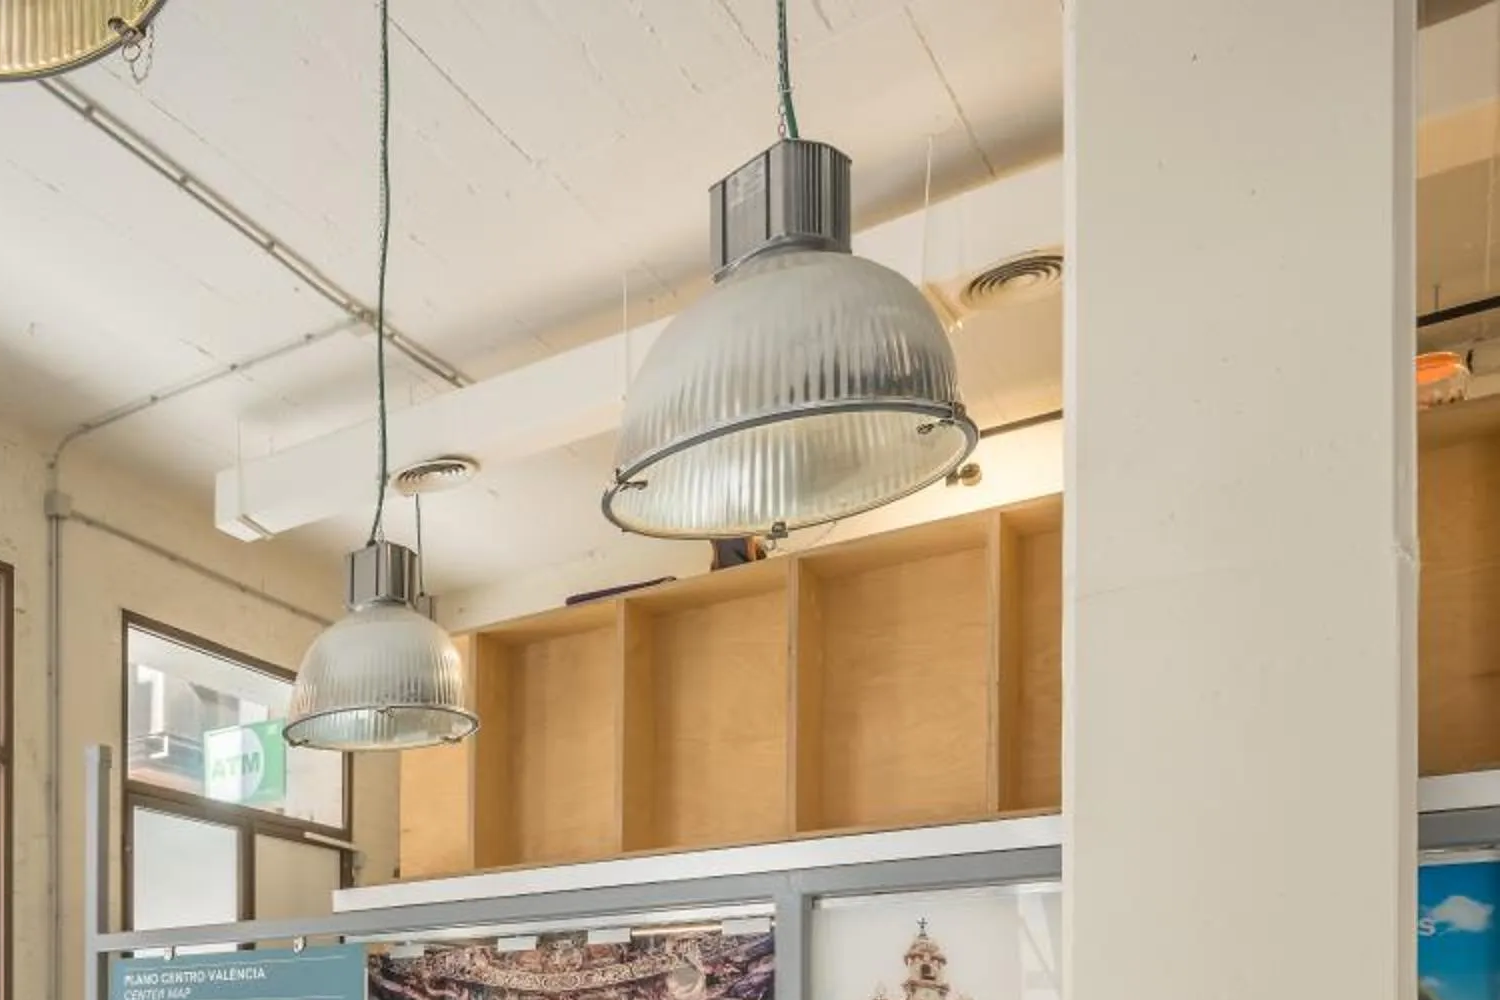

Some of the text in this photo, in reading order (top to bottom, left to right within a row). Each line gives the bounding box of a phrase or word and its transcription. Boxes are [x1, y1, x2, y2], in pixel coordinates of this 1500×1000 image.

[211, 751, 260, 781] ATM
[124, 966, 266, 986] PLANO CENTRO VALENCIA
[167, 987, 192, 999] MAP
